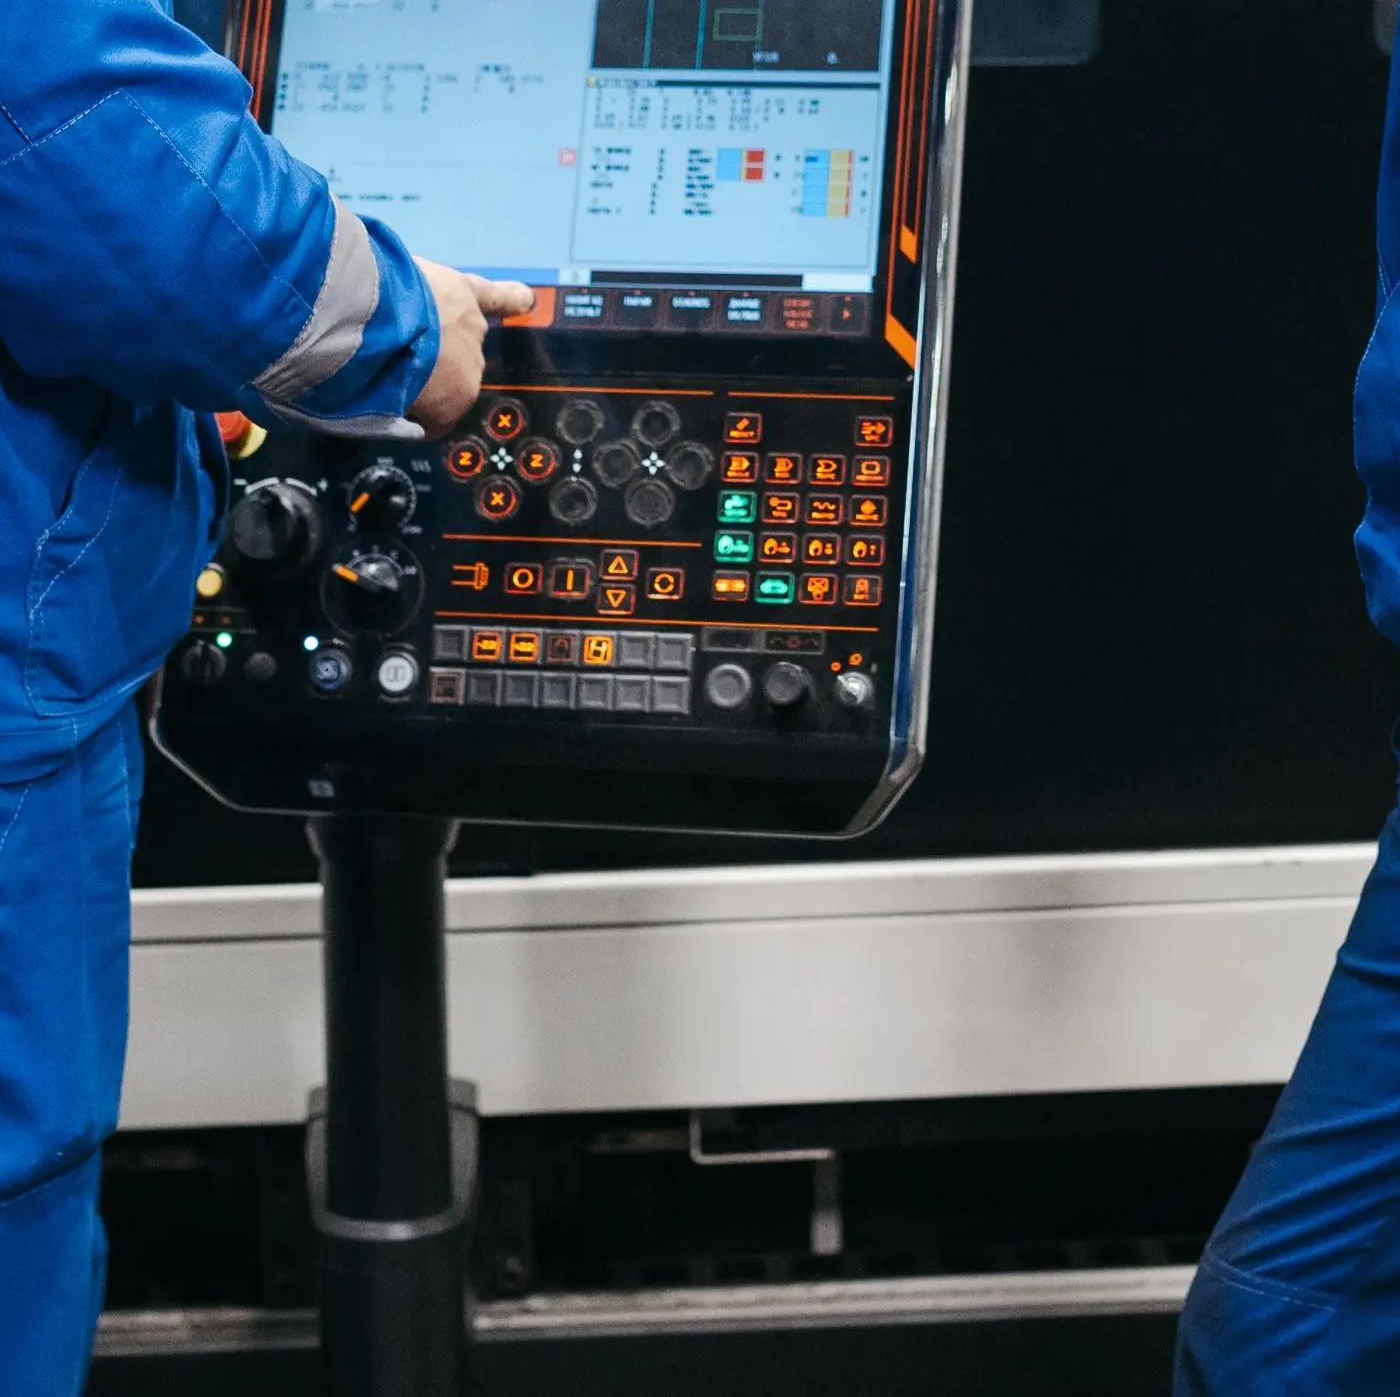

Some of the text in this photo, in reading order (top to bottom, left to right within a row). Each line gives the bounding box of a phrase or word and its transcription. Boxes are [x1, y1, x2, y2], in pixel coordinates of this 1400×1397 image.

[498, 414, 512, 428] X
[459, 451, 473, 466] Z
[530, 453, 544, 468] Z
[490, 491, 505, 506] X
